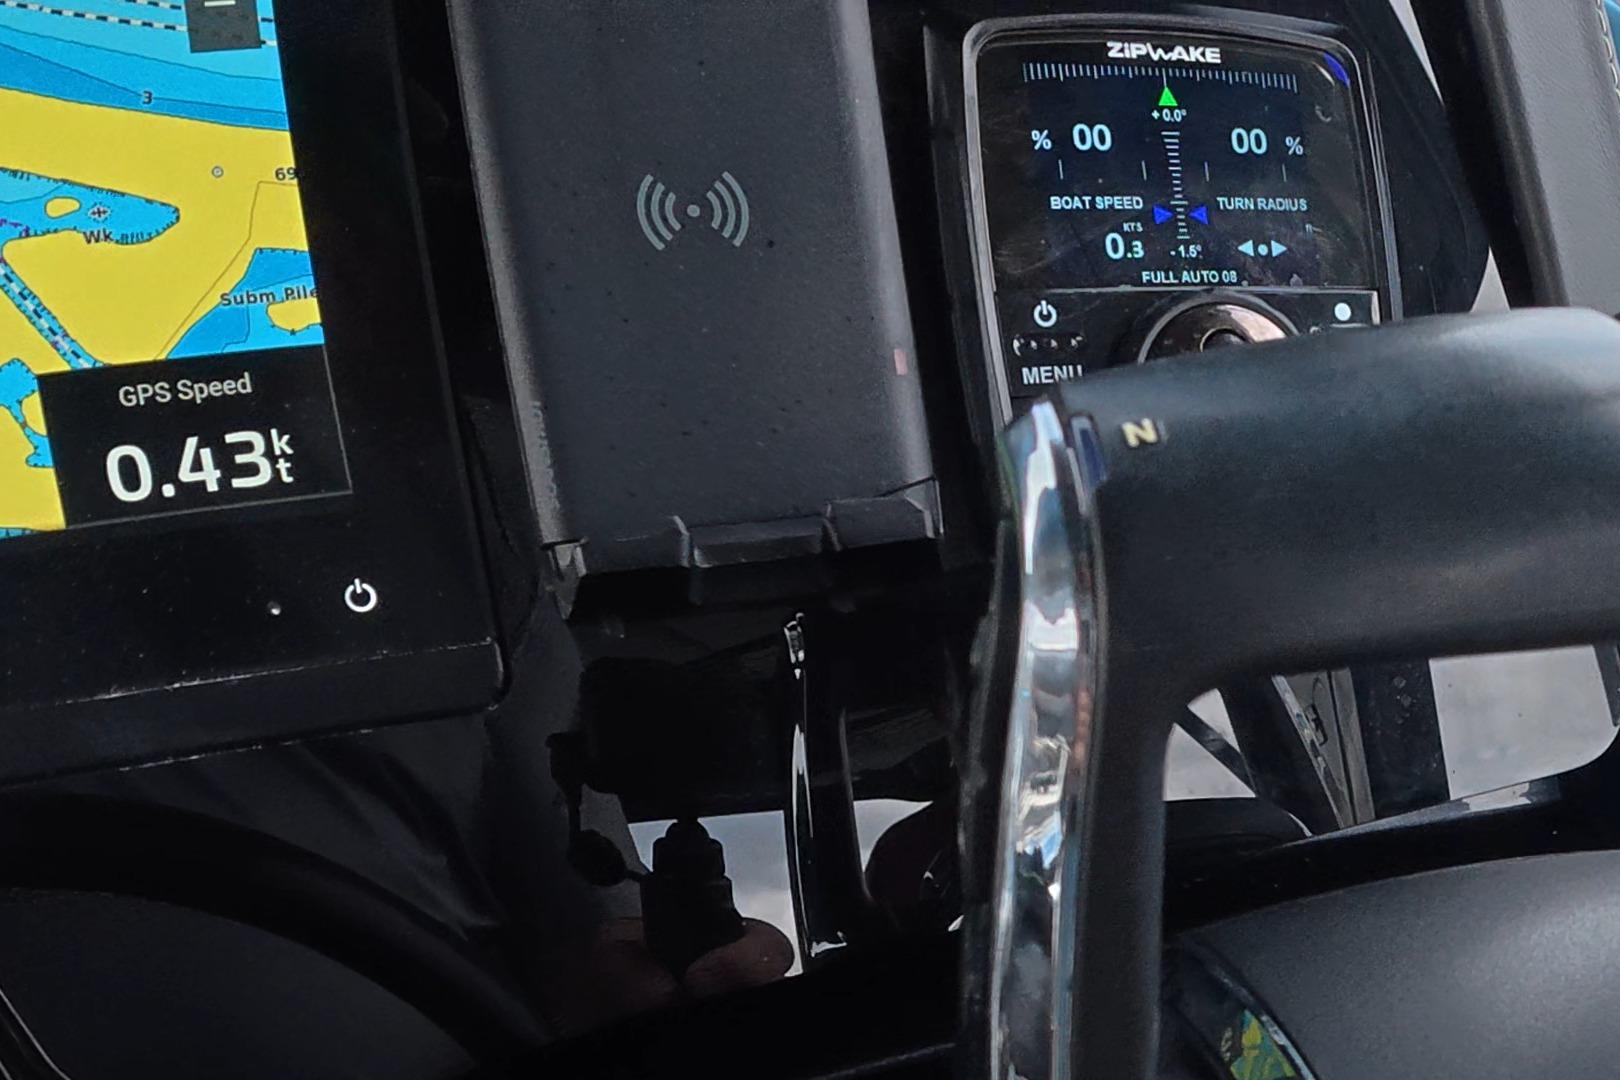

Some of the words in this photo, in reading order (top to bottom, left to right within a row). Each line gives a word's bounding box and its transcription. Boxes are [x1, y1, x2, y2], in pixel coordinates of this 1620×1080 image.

[142, 90, 153, 105] 3
[1031, 129, 1052, 150] %
[1072, 123, 1112, 151] 00
[1231, 127, 1267, 154] 00
[1285, 135, 1304, 155] %
[1050, 195, 1091, 210] BOAT
[1095, 195, 1143, 210] SPEED
[1216, 196, 1254, 210] TURN
[1257, 197, 1308, 212] RADIUS
[83, 229, 113, 244] Wk
[1105, 232, 1144, 260] 0.3
[1141, 270, 1178, 284] FULL
[1181, 270, 1219, 284] AUTO
[220, 292, 276, 308] Subm
[118, 381, 172, 407] GPS
[176, 371, 253, 404] Speed
[1121, 417, 1158, 448] N
[106, 430, 272, 502] 0.43
